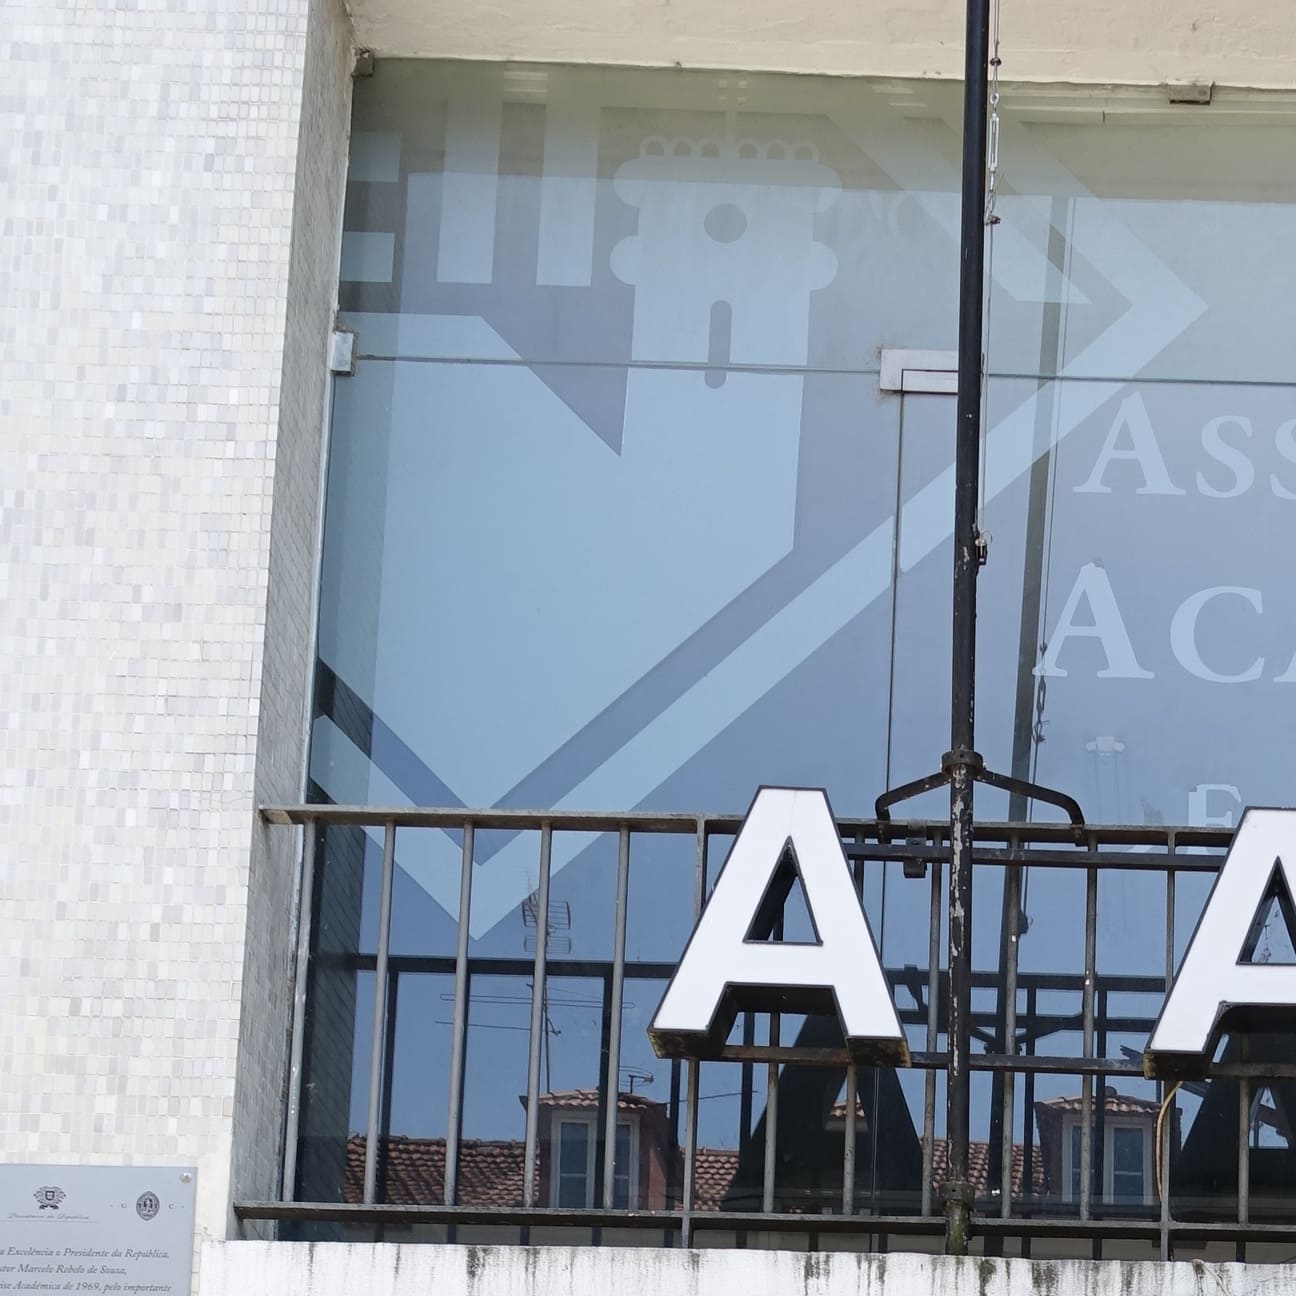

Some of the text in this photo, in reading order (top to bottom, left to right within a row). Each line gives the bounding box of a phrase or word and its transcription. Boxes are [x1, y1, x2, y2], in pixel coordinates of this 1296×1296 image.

[63, 1248, 110, 1258] Presidente
[111, 1249, 122, 1257] da
[17, 1264, 54, 1274] Marcelo
[55, 1264, 86, 1274] Rebelo
[87, 1265, 98, 1275] de
[13, 1281, 172, 1295] Académica de 1969, pelo importante
